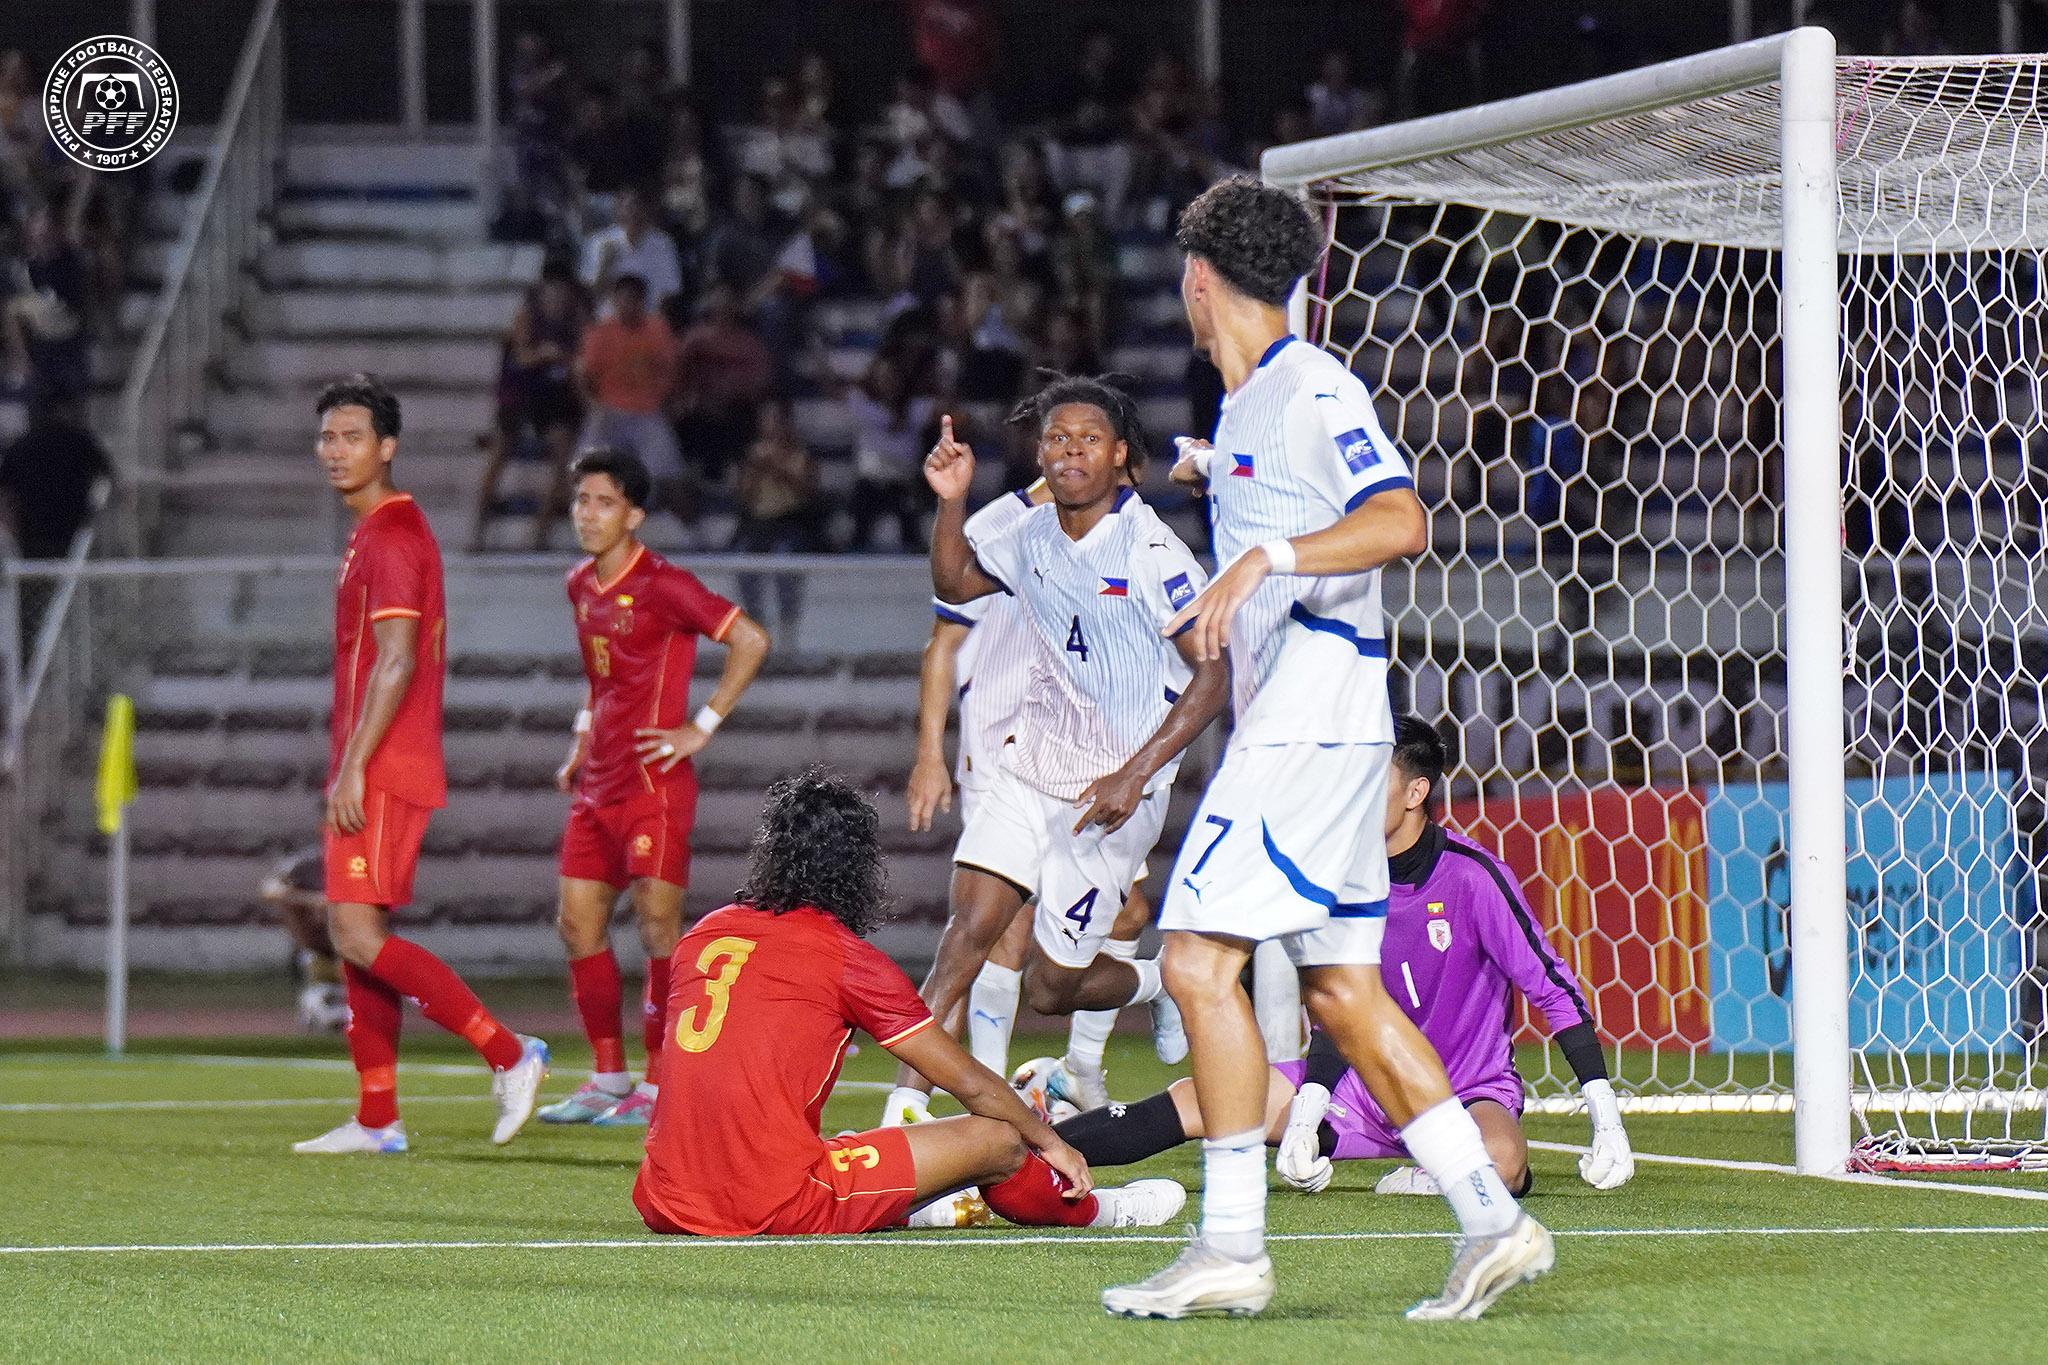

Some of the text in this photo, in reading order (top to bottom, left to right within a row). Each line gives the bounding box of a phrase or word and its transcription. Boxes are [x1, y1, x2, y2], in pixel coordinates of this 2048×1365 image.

[1171, 583, 1192, 601] AFC
[1066, 615, 1089, 662] 4
[1191, 814, 1234, 875] 7
[1065, 887, 1100, 932] 4
[676, 936, 758, 1053] 3
[1401, 961, 1421, 1009] 1
[829, 1145, 881, 1172] 3
